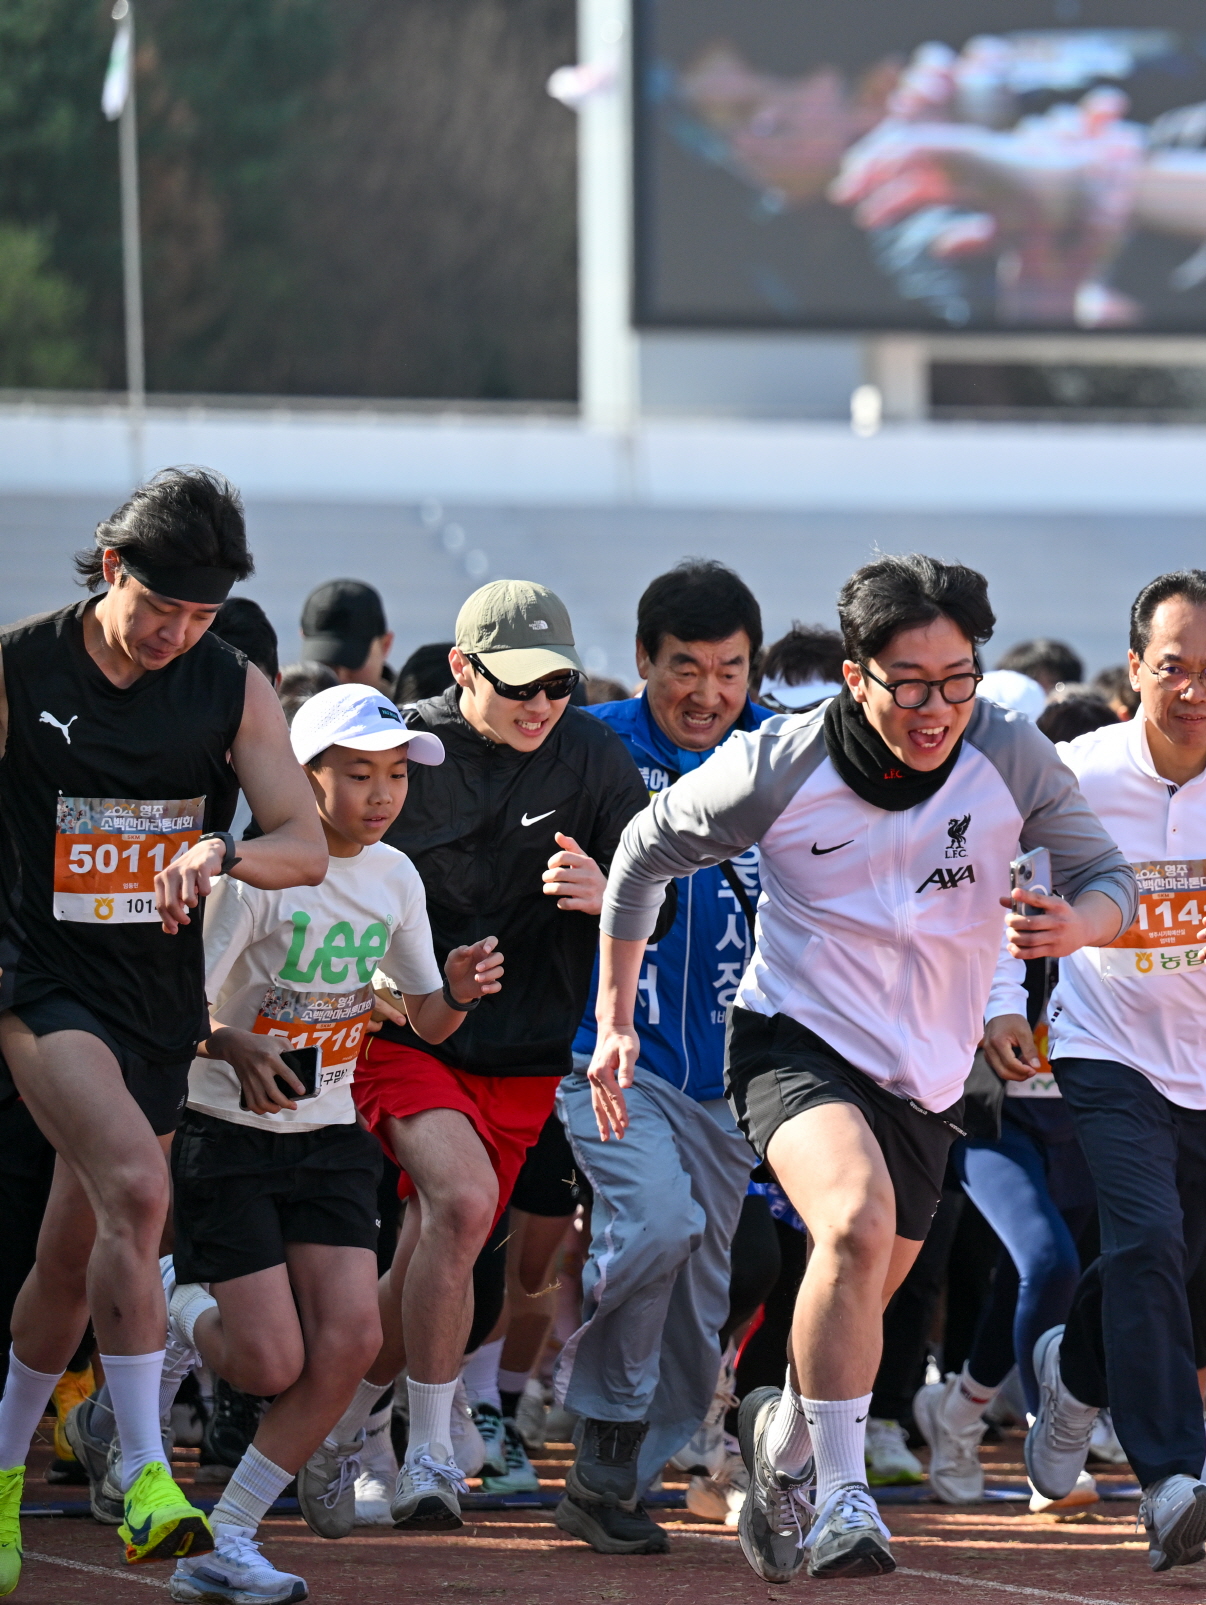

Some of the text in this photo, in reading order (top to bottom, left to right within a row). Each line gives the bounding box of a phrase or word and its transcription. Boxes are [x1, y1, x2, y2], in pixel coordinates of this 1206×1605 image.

[104, 803, 164, 817] 2026 영주
[100, 816, 193, 832] 소백산마라톤대회
[1165, 864, 1188, 877] 영주
[915, 864, 976, 894] AXA
[126, 898, 158, 914] 101
[278, 911, 388, 985] Lee
[338, 994, 355, 1008] 영주
